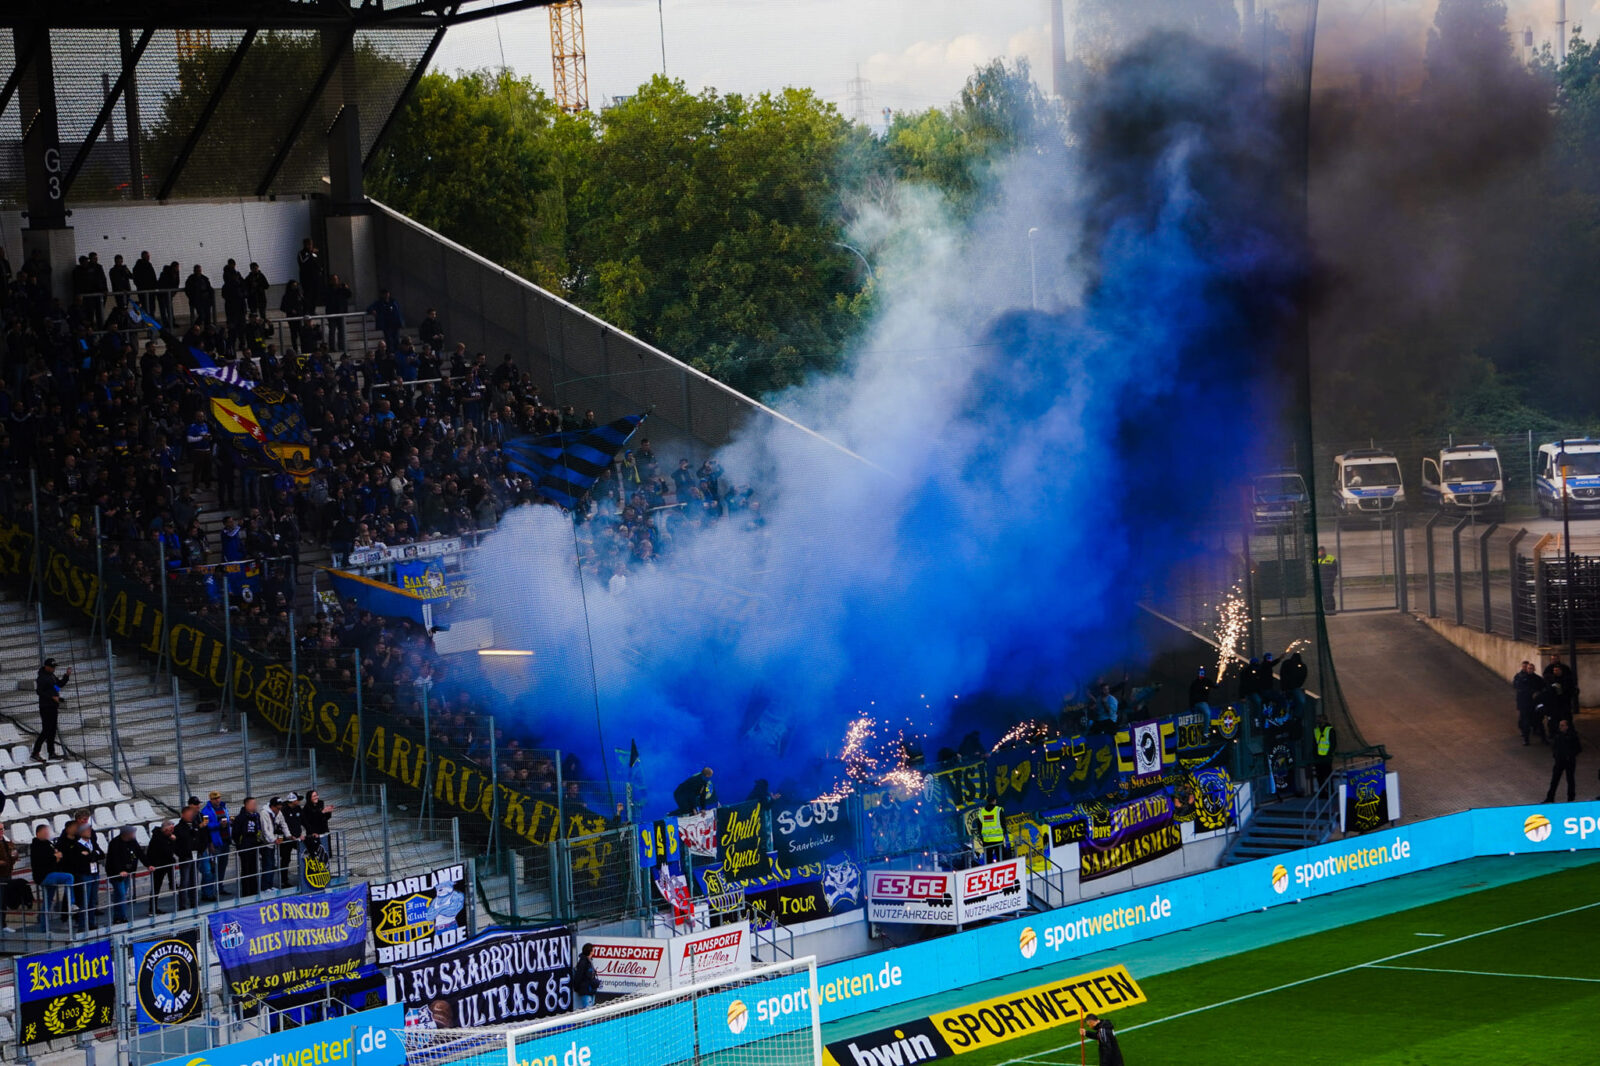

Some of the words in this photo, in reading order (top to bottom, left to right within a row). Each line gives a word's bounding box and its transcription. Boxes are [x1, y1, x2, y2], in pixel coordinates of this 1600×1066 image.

[45, 149, 61, 172] G
[49, 177, 61, 199] 3
[777, 802, 839, 835] SC95
[1113, 796, 1170, 832] FREUNDE
[1563, 815, 1600, 839] sp
[1081, 824, 1182, 877] SAARKASMUS
[1295, 836, 1411, 887] sportwetten.de
[371, 864, 465, 902] SAARLAND
[260, 902, 280, 924] FCS
[281, 901, 331, 919] FANCLUB
[780, 895, 817, 915] TOUR
[873, 908, 954, 921] NUTZFAHRZEUGE
[964, 896, 1022, 919] NUTZFAHRZEUGE
[1044, 894, 1172, 951] sportwetten.de
[249, 930, 282, 956] ALTES
[283, 923, 349, 948] VIRTSHAUS
[377, 925, 468, 964] BRIGADE
[594, 945, 660, 960] TRANSPORTE
[688, 932, 740, 955] TRANSPORTE
[146, 944, 173, 972] FAMILY
[173, 944, 194, 963] CLUB
[439, 933, 573, 996] SAARBRÜCKEN
[597, 960, 648, 976] Müller
[26, 953, 110, 993] Kaliber
[264, 974, 280, 988] so
[300, 964, 325, 979] wir
[60, 1006, 81, 1022] 1903
[153, 989, 192, 1014] SAAR
[458, 980, 540, 1028] ULTRAS
[544, 973, 571, 1013] 85
[942, 971, 1139, 1048] SPORTWETTEN
[848, 1029, 937, 1066] bwin
